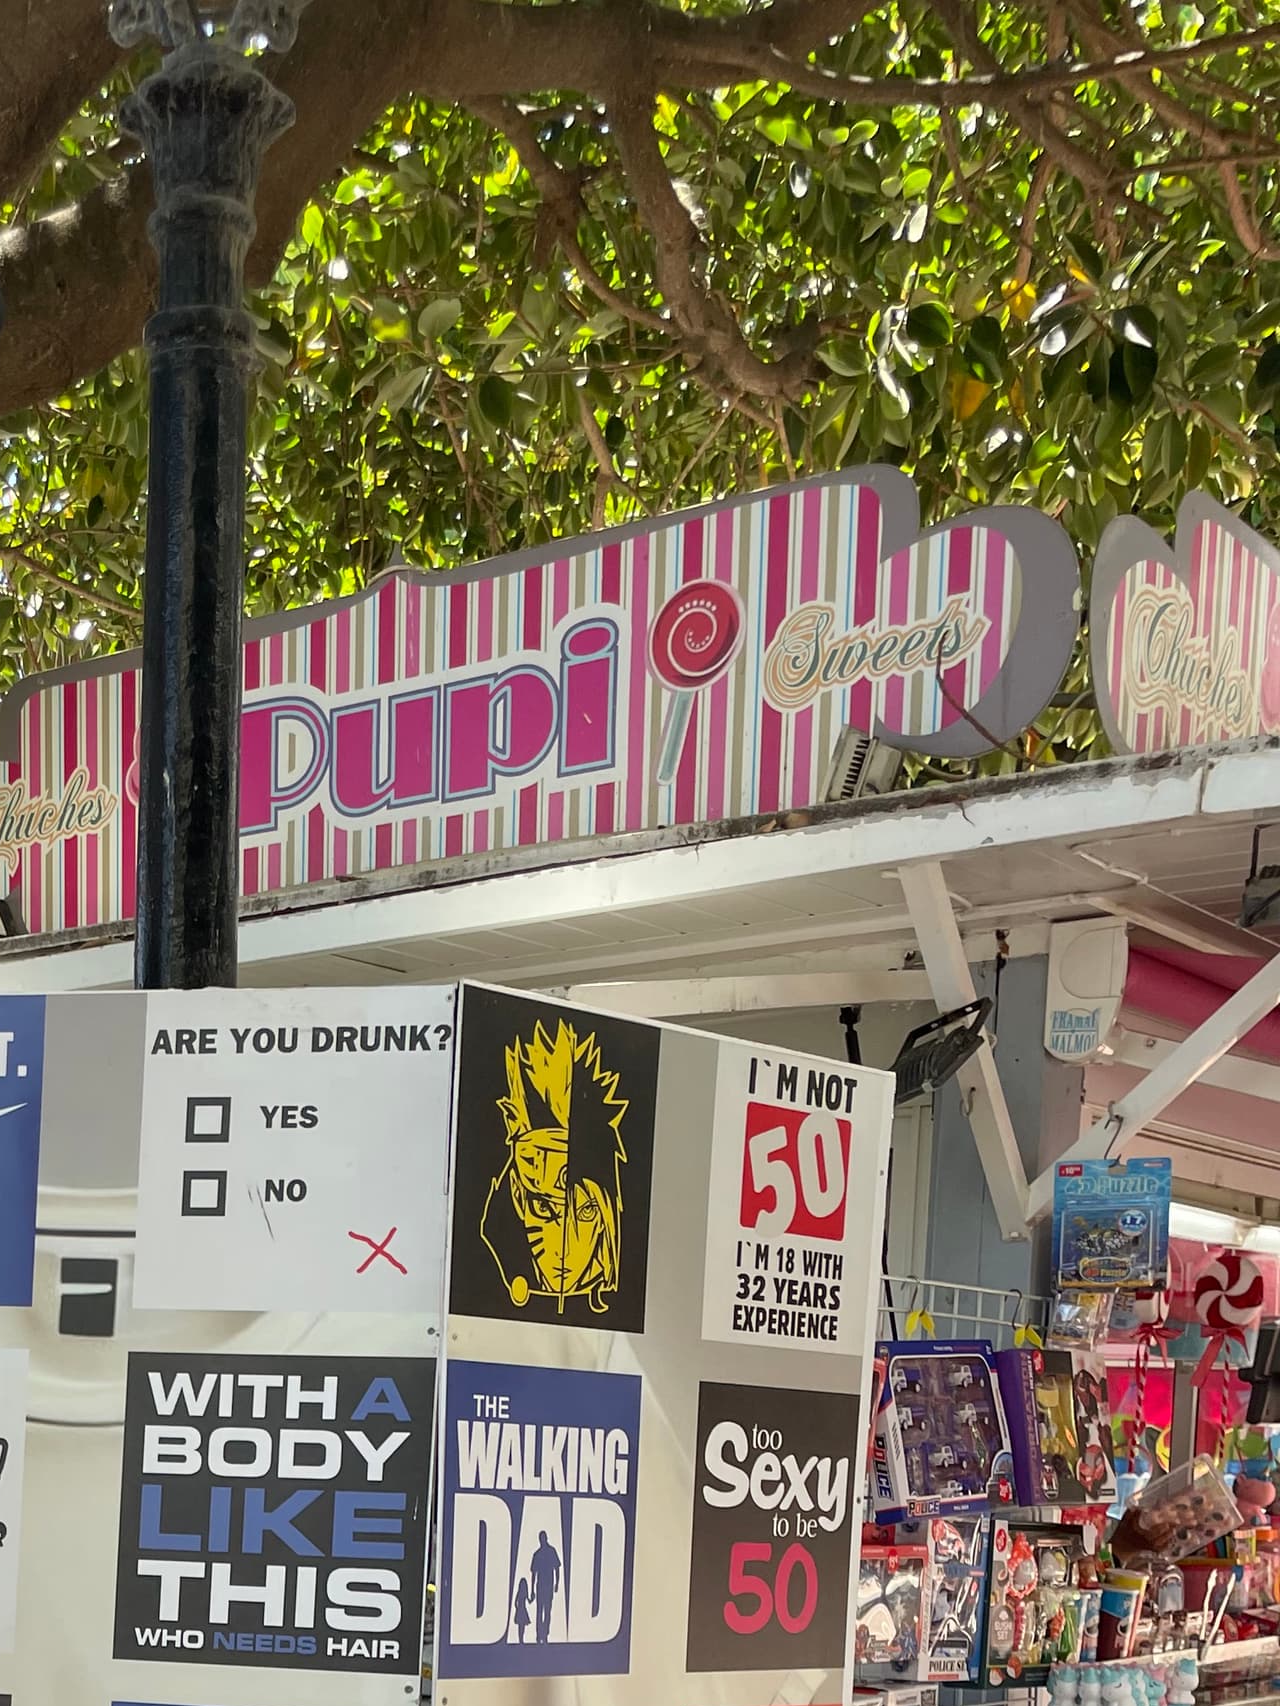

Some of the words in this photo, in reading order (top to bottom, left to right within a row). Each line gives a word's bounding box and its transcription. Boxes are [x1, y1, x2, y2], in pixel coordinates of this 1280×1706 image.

[778, 608, 966, 688] Sweets
[1142, 600, 1245, 723] Chuches
[151, 1029, 218, 1055] ARE
[230, 1027, 299, 1054] YOU
[311, 1024, 452, 1053] DRUNK?
[260, 1105, 319, 1129] YES
[264, 1179, 308, 1202] NO
[1098, 1175, 1160, 1195] Puzzle
[735, 1273, 766, 1301] 32
[772, 1277, 841, 1311] YEARS
[732, 1304, 838, 1341] EXPERIENCE
[147, 1371, 339, 1421] WITH
[349, 1377, 412, 1422] A
[473, 1394, 510, 1419] THE
[141, 1424, 412, 1482] BODY
[752, 1423, 783, 1450] too
[456, 1419, 629, 1495] WALKING
[875, 1436, 894, 1501] POLICE
[138, 1483, 407, 1560] LIKE
[772, 1512, 789, 1537] to
[796, 1512, 818, 1538] be
[909, 1500, 941, 1516] POLICE
[449, 1492, 626, 1645] DAD
[723, 1541, 818, 1634] 50
[137, 1559, 402, 1633] THIS
[134, 1627, 205, 1649] WHO
[212, 1632, 317, 1654] NEEDS
[326, 1637, 400, 1660] HAIR
